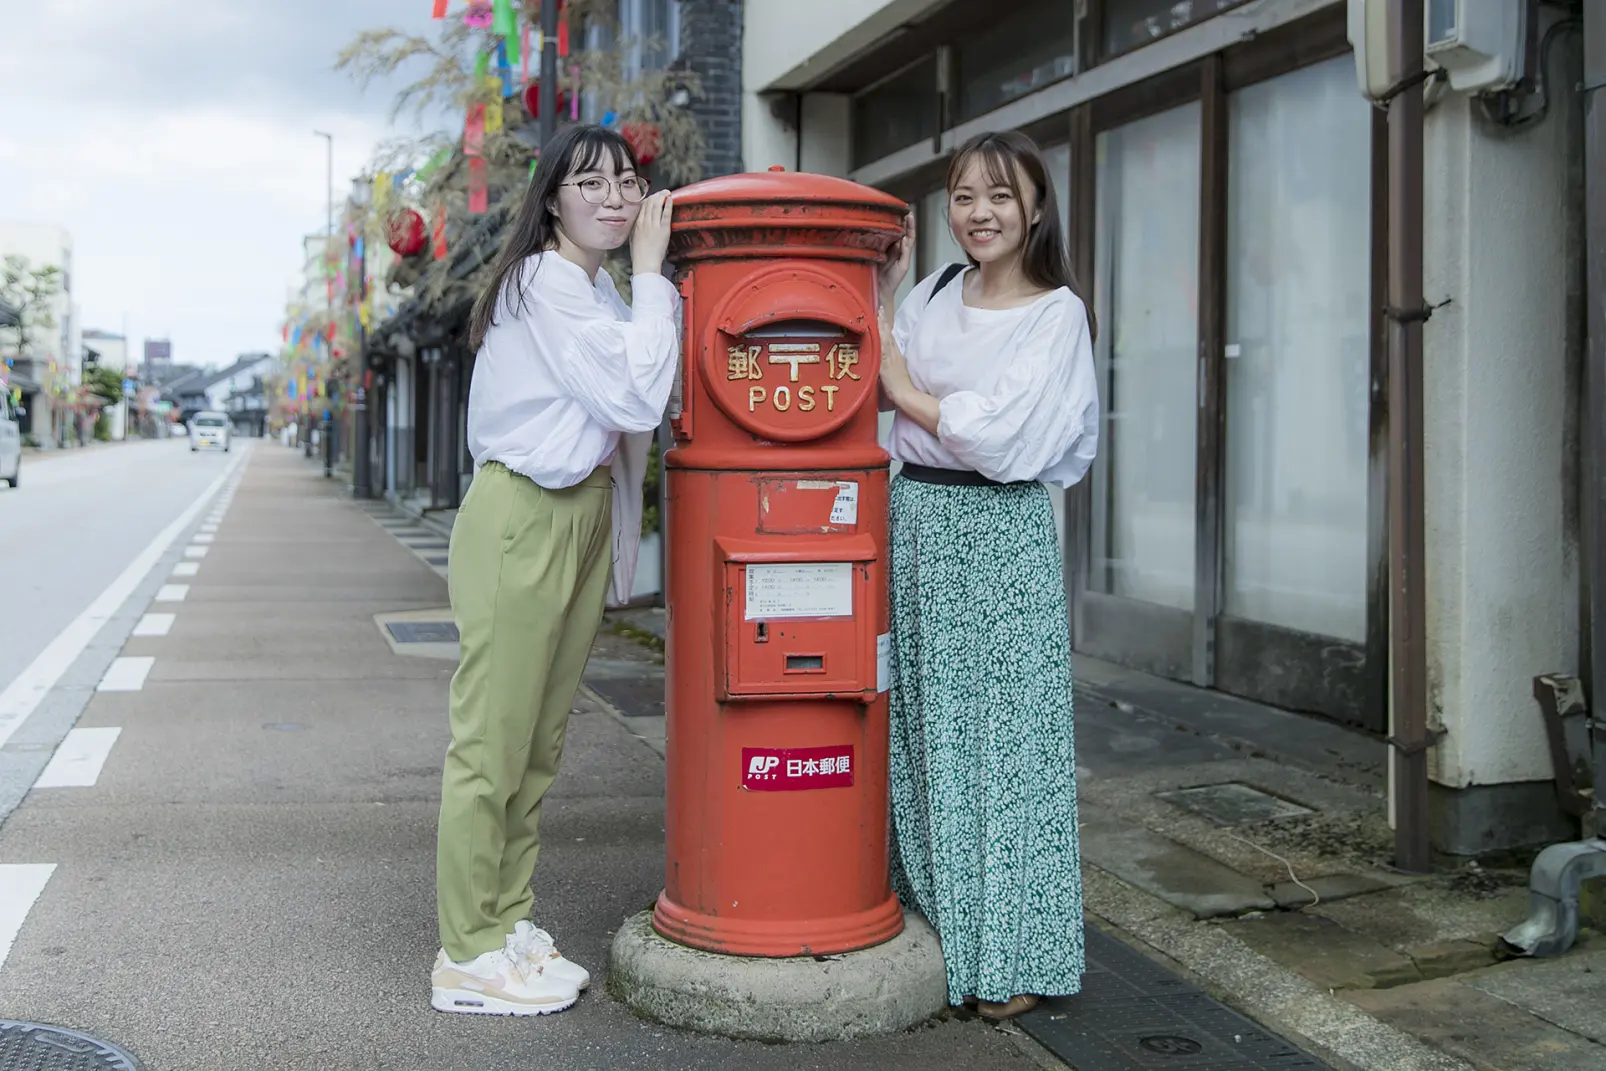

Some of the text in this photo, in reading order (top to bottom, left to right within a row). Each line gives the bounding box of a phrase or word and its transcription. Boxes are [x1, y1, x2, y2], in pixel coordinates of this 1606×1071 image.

[748, 385, 840, 412] POST
[787, 755, 851, 777] 日本郵便
